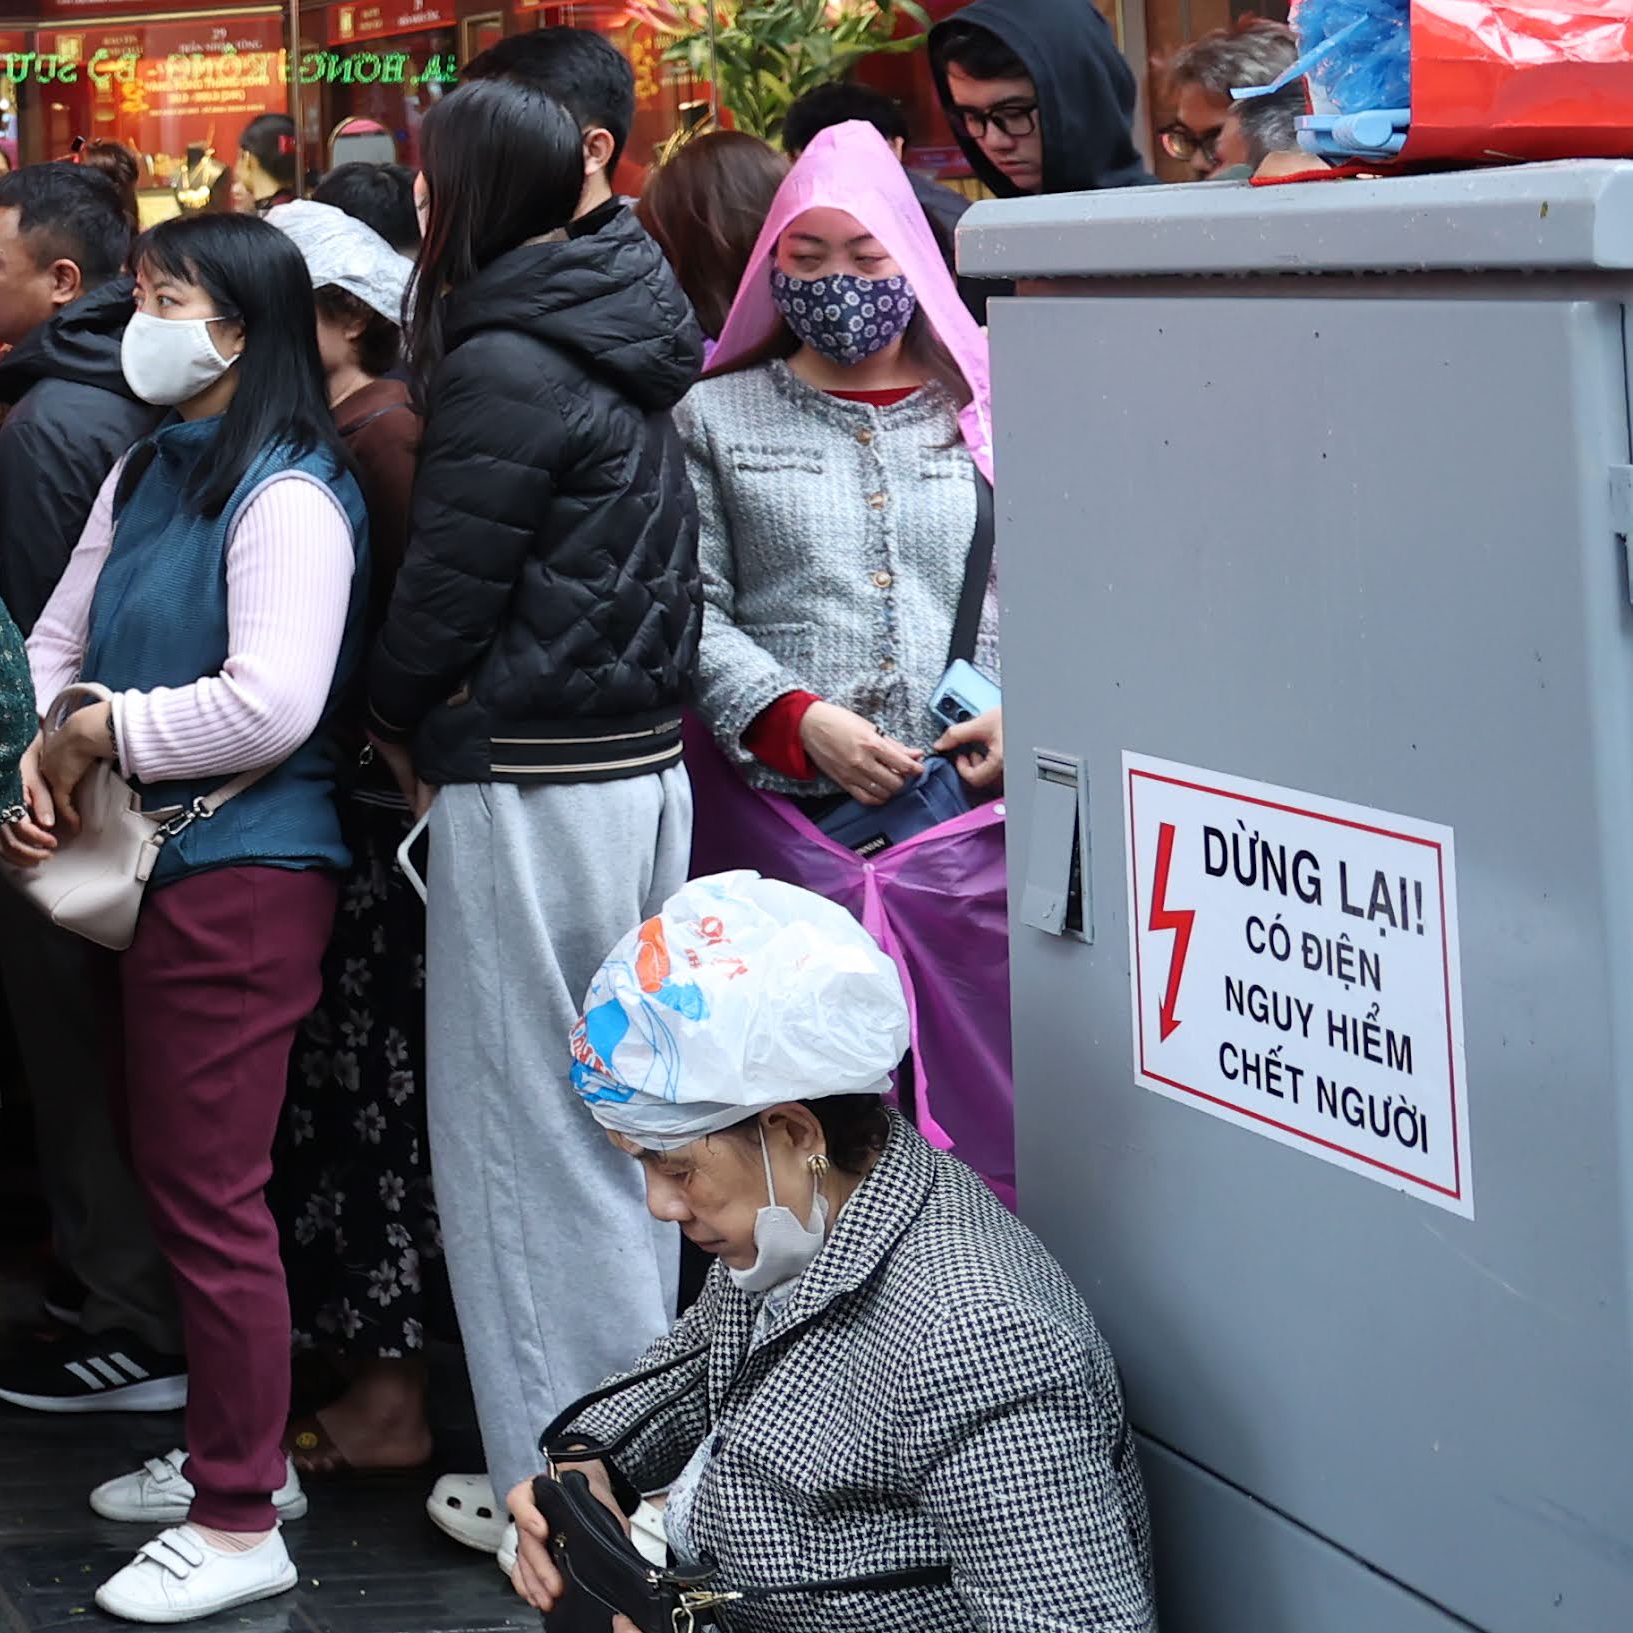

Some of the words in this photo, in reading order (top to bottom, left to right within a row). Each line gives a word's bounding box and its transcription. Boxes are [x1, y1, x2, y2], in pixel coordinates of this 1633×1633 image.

[1203, 819, 1323, 906] DỪNG
[1338, 860, 1426, 937] LẠI!
[1245, 913, 1291, 961] CÓ
[1301, 931, 1382, 991] ĐIỆN
[1224, 975, 1314, 1038] NGUY
[1327, 1003, 1413, 1075] HIỂM
[1218, 1042, 1305, 1105] CHẾT
[1317, 1076, 1429, 1153] NGƯỜI
